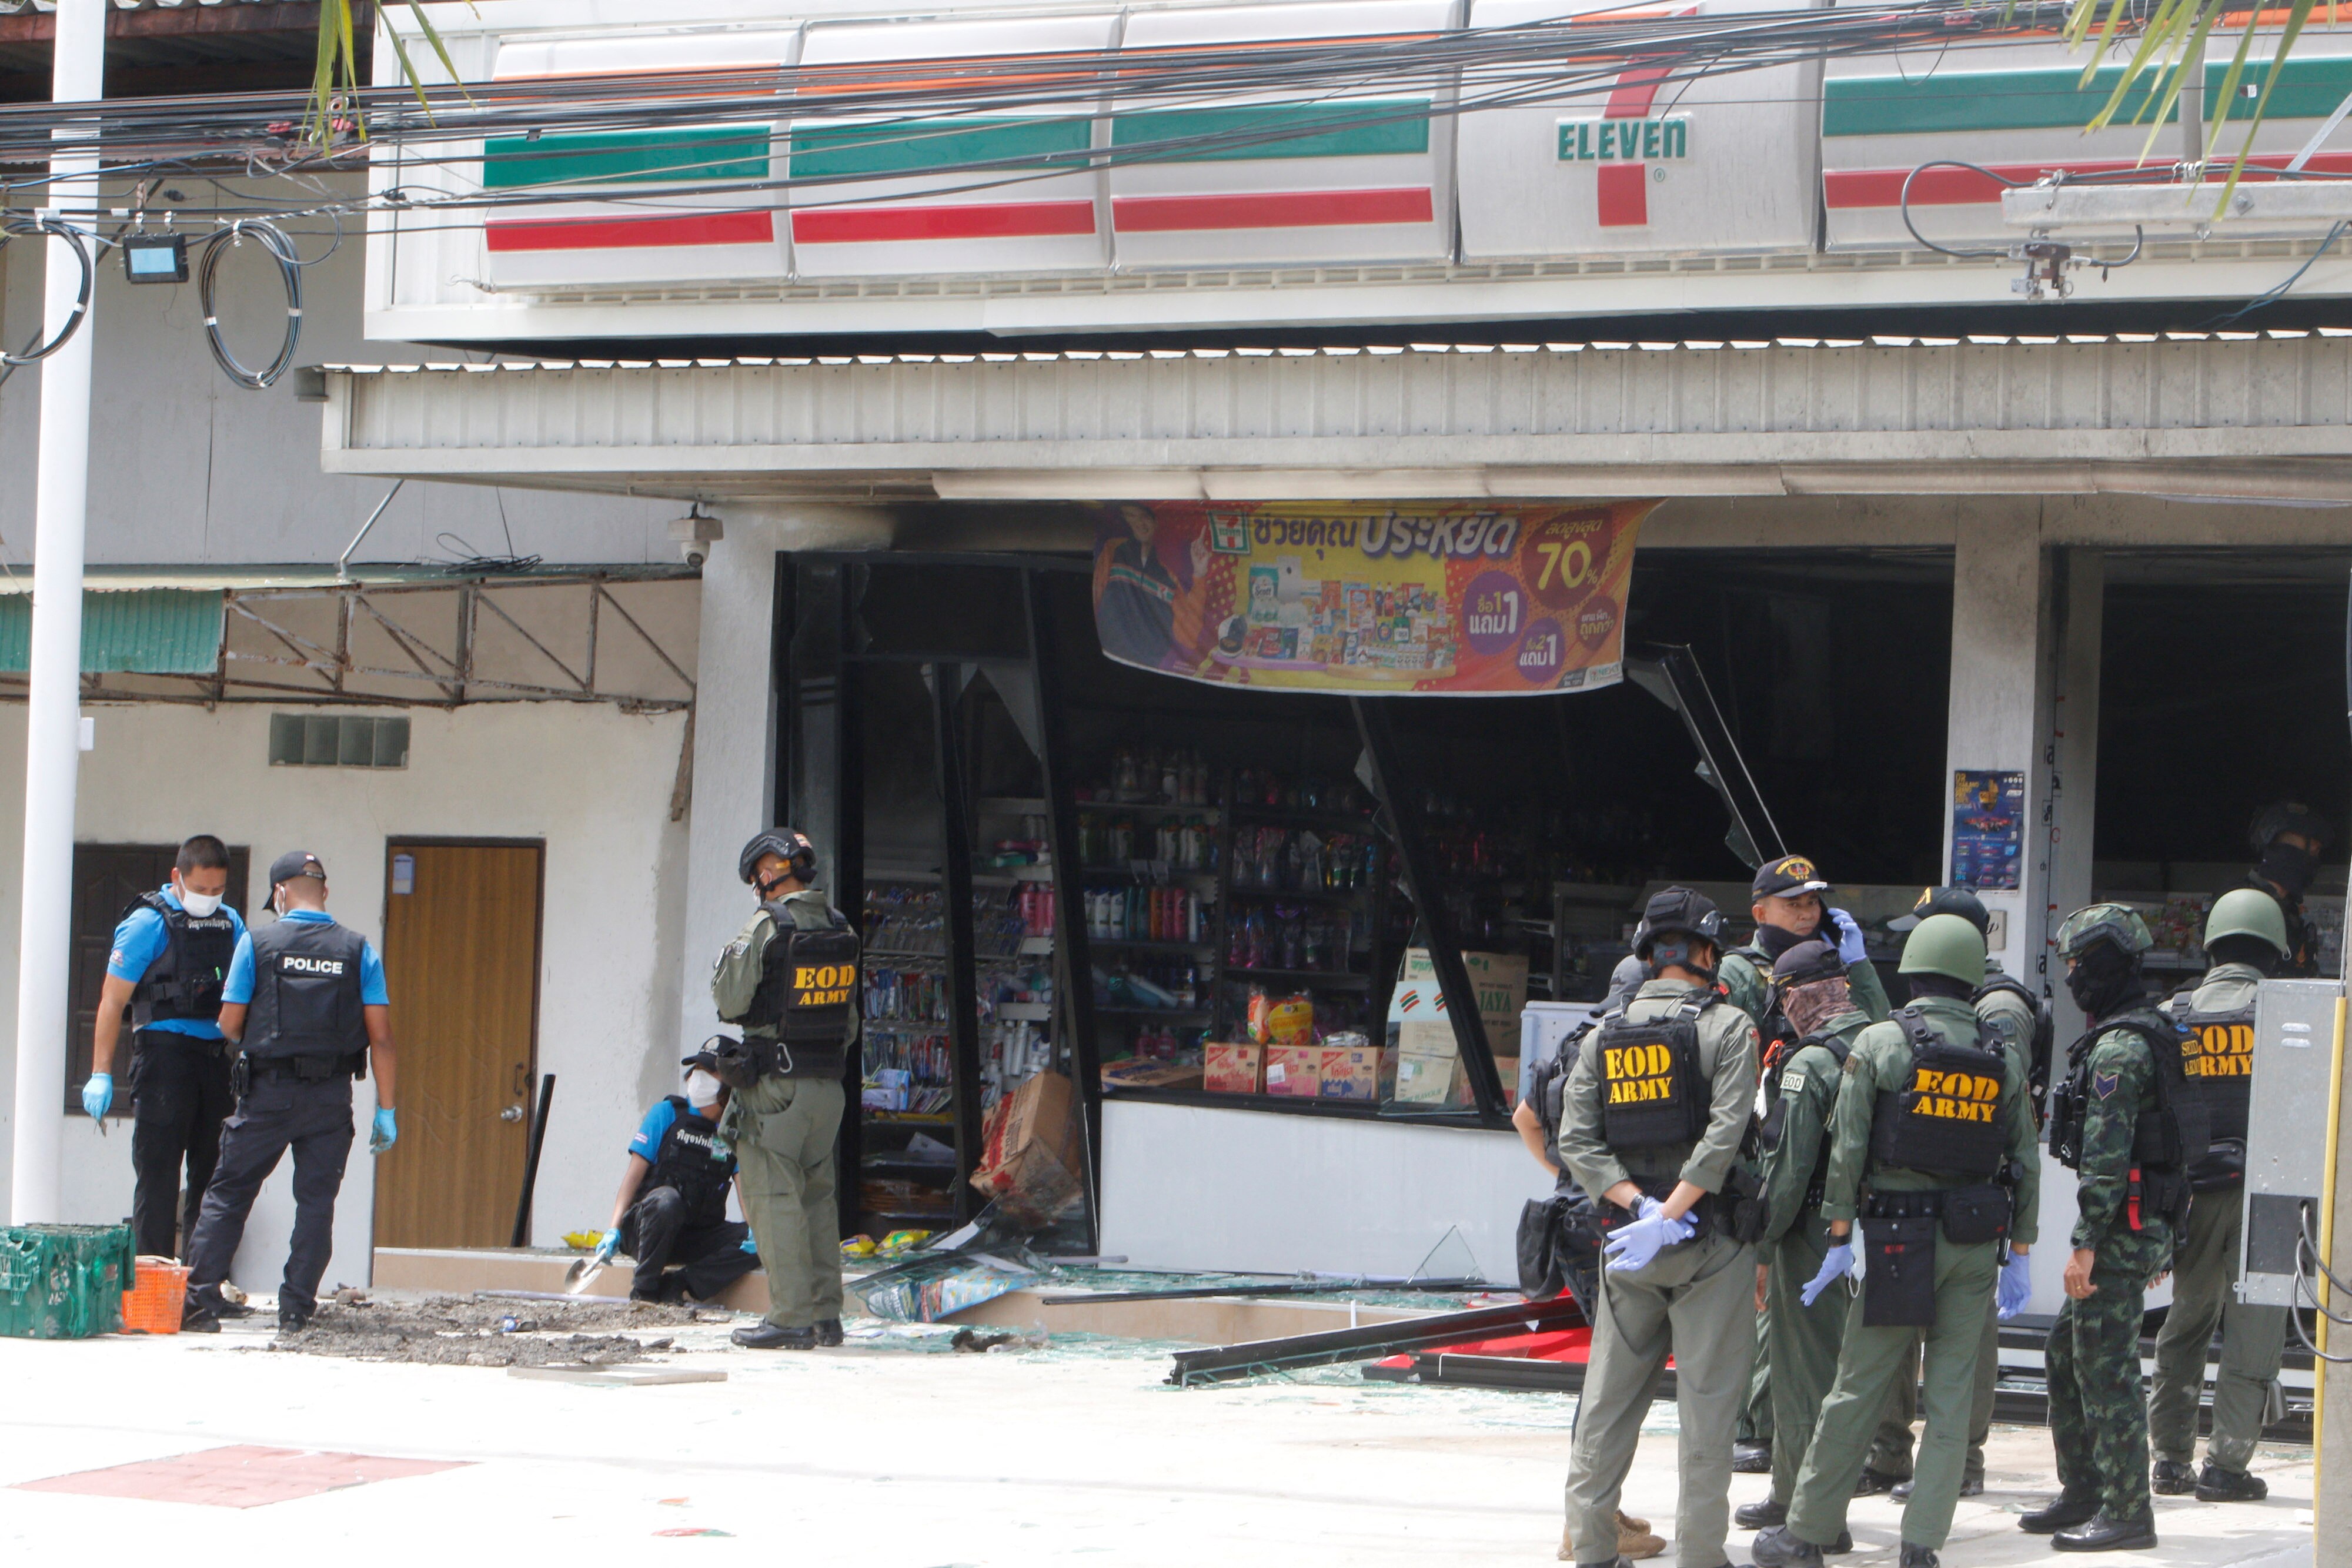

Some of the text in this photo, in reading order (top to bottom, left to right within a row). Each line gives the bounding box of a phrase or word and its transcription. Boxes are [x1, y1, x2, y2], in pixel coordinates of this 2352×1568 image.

[283, 957, 343, 974] POLICE
[794, 965, 856, 988] EOD
[799, 989, 850, 1005] ARMY
[1604, 1044, 1671, 1079] EOD
[2200, 1054, 2253, 1076] RMY
[1609, 1076, 1672, 1104] ARMY
[1783, 1075, 1802, 1088] EOD
[1913, 1069, 1999, 1101] EOD
[1912, 1096, 1996, 1123] ARMY
